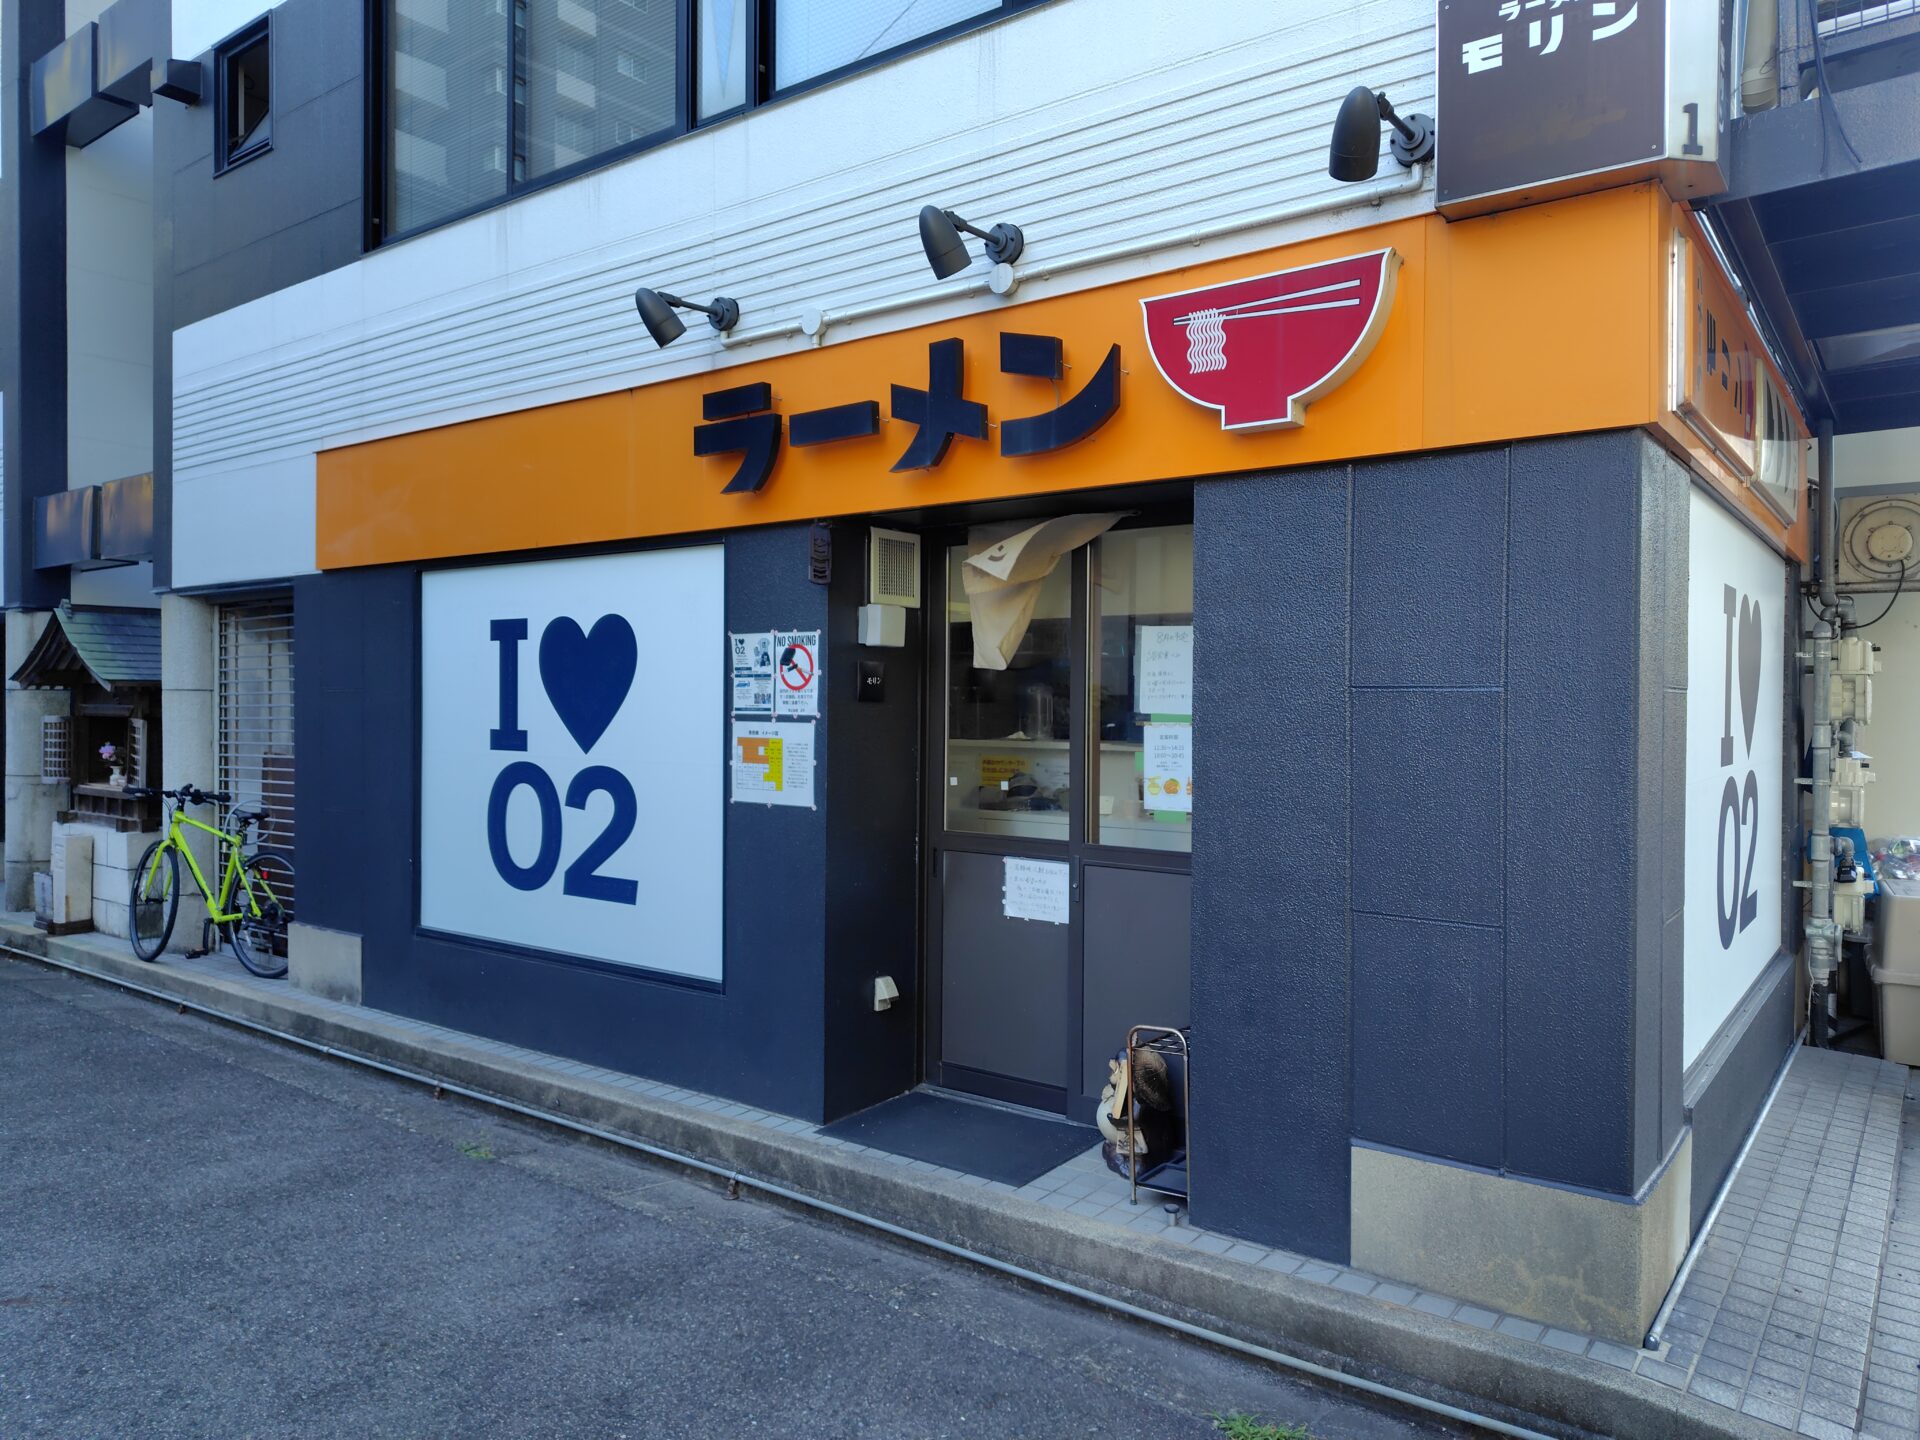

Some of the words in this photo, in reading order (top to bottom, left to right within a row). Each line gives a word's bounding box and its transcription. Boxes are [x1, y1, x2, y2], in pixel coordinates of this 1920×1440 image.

[1462, 1, 1638, 75] モリン
[1682, 102, 1703, 156] 1
[694, 332, 1121, 494] ラーメン
[777, 636, 786, 647] NO
[788, 635, 816, 647] SMOKING
[1720, 583, 1737, 768] I
[490, 618, 528, 752] I
[866, 676, 881, 685] モリン
